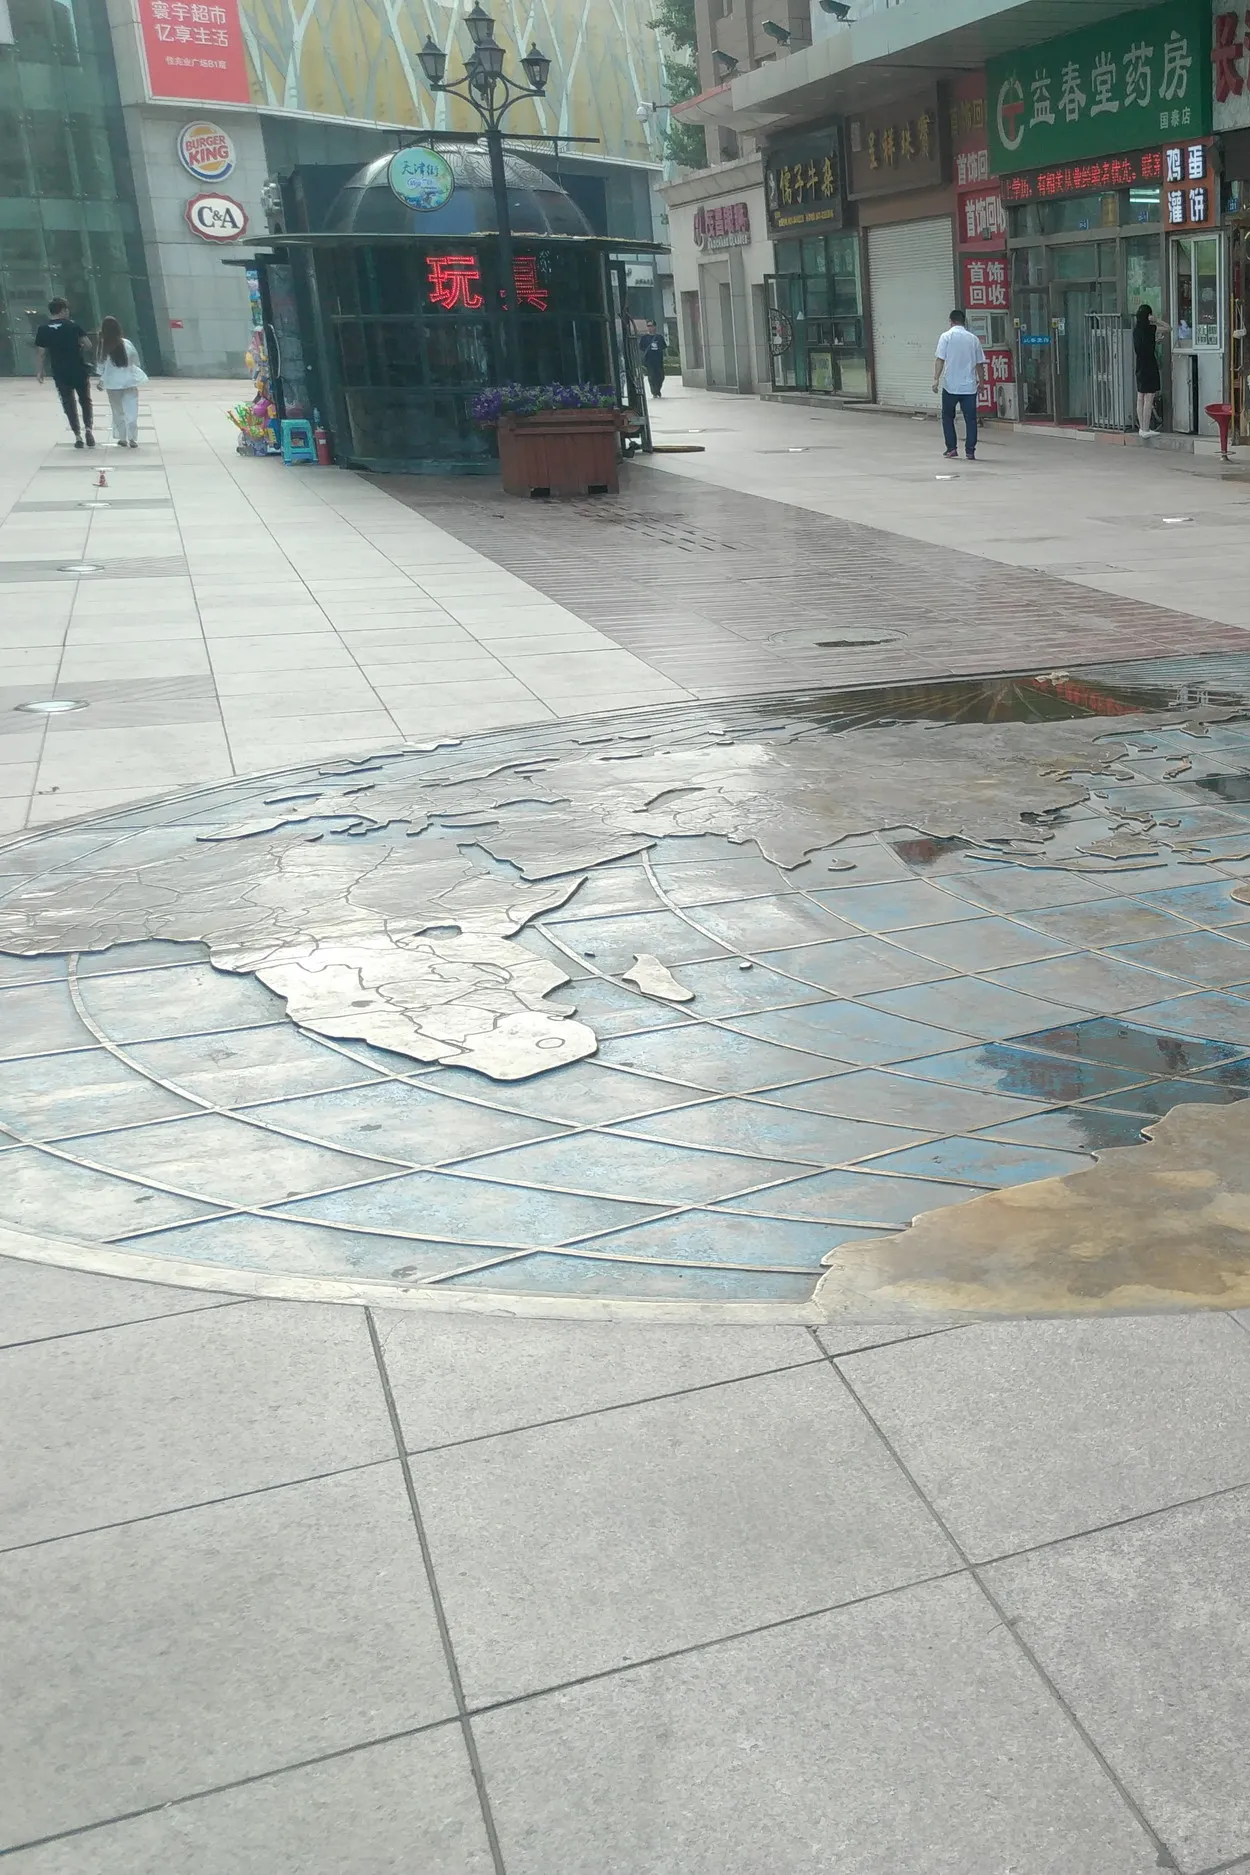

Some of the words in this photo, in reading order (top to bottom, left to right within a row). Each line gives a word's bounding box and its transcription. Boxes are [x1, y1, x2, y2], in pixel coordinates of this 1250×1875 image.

[151, 1, 226, 24] 寰宇超市
[154, 23, 229, 47] 亿享生活
[1028, 30, 1193, 130] 益春堂药房
[1159, 105, 1192, 129] 国泰店
[184, 135, 226, 152] BURGER
[188, 145, 229, 167] KING
[1166, 145, 1203, 183] 鸡蛋
[401, 160, 439, 177] 天津街
[197, 205, 240, 229] C&A
[1168, 188, 1209, 224] 灌饼
[427, 256, 548, 312] 玩具
[968, 262, 1004, 283] 首饰
[970, 285, 1006, 305] 回收
